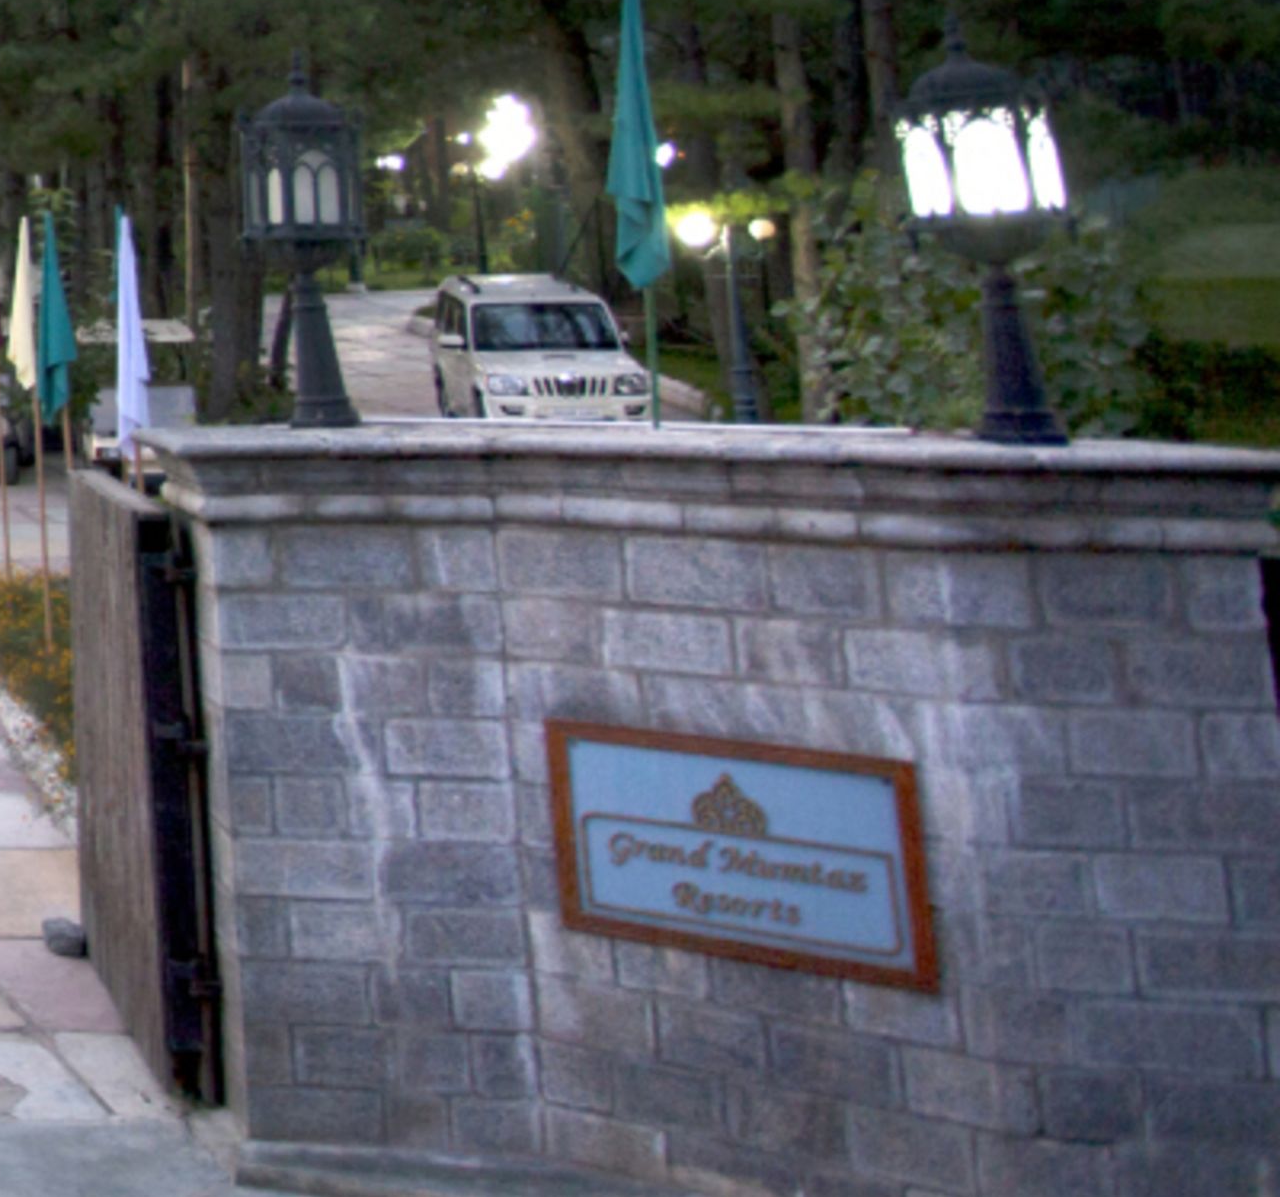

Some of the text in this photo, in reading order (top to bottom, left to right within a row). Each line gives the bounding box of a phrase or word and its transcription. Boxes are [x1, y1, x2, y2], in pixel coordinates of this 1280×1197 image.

[608, 831, 868, 893] Grand Mumtaz
[672, 882, 801, 925] Resorts
